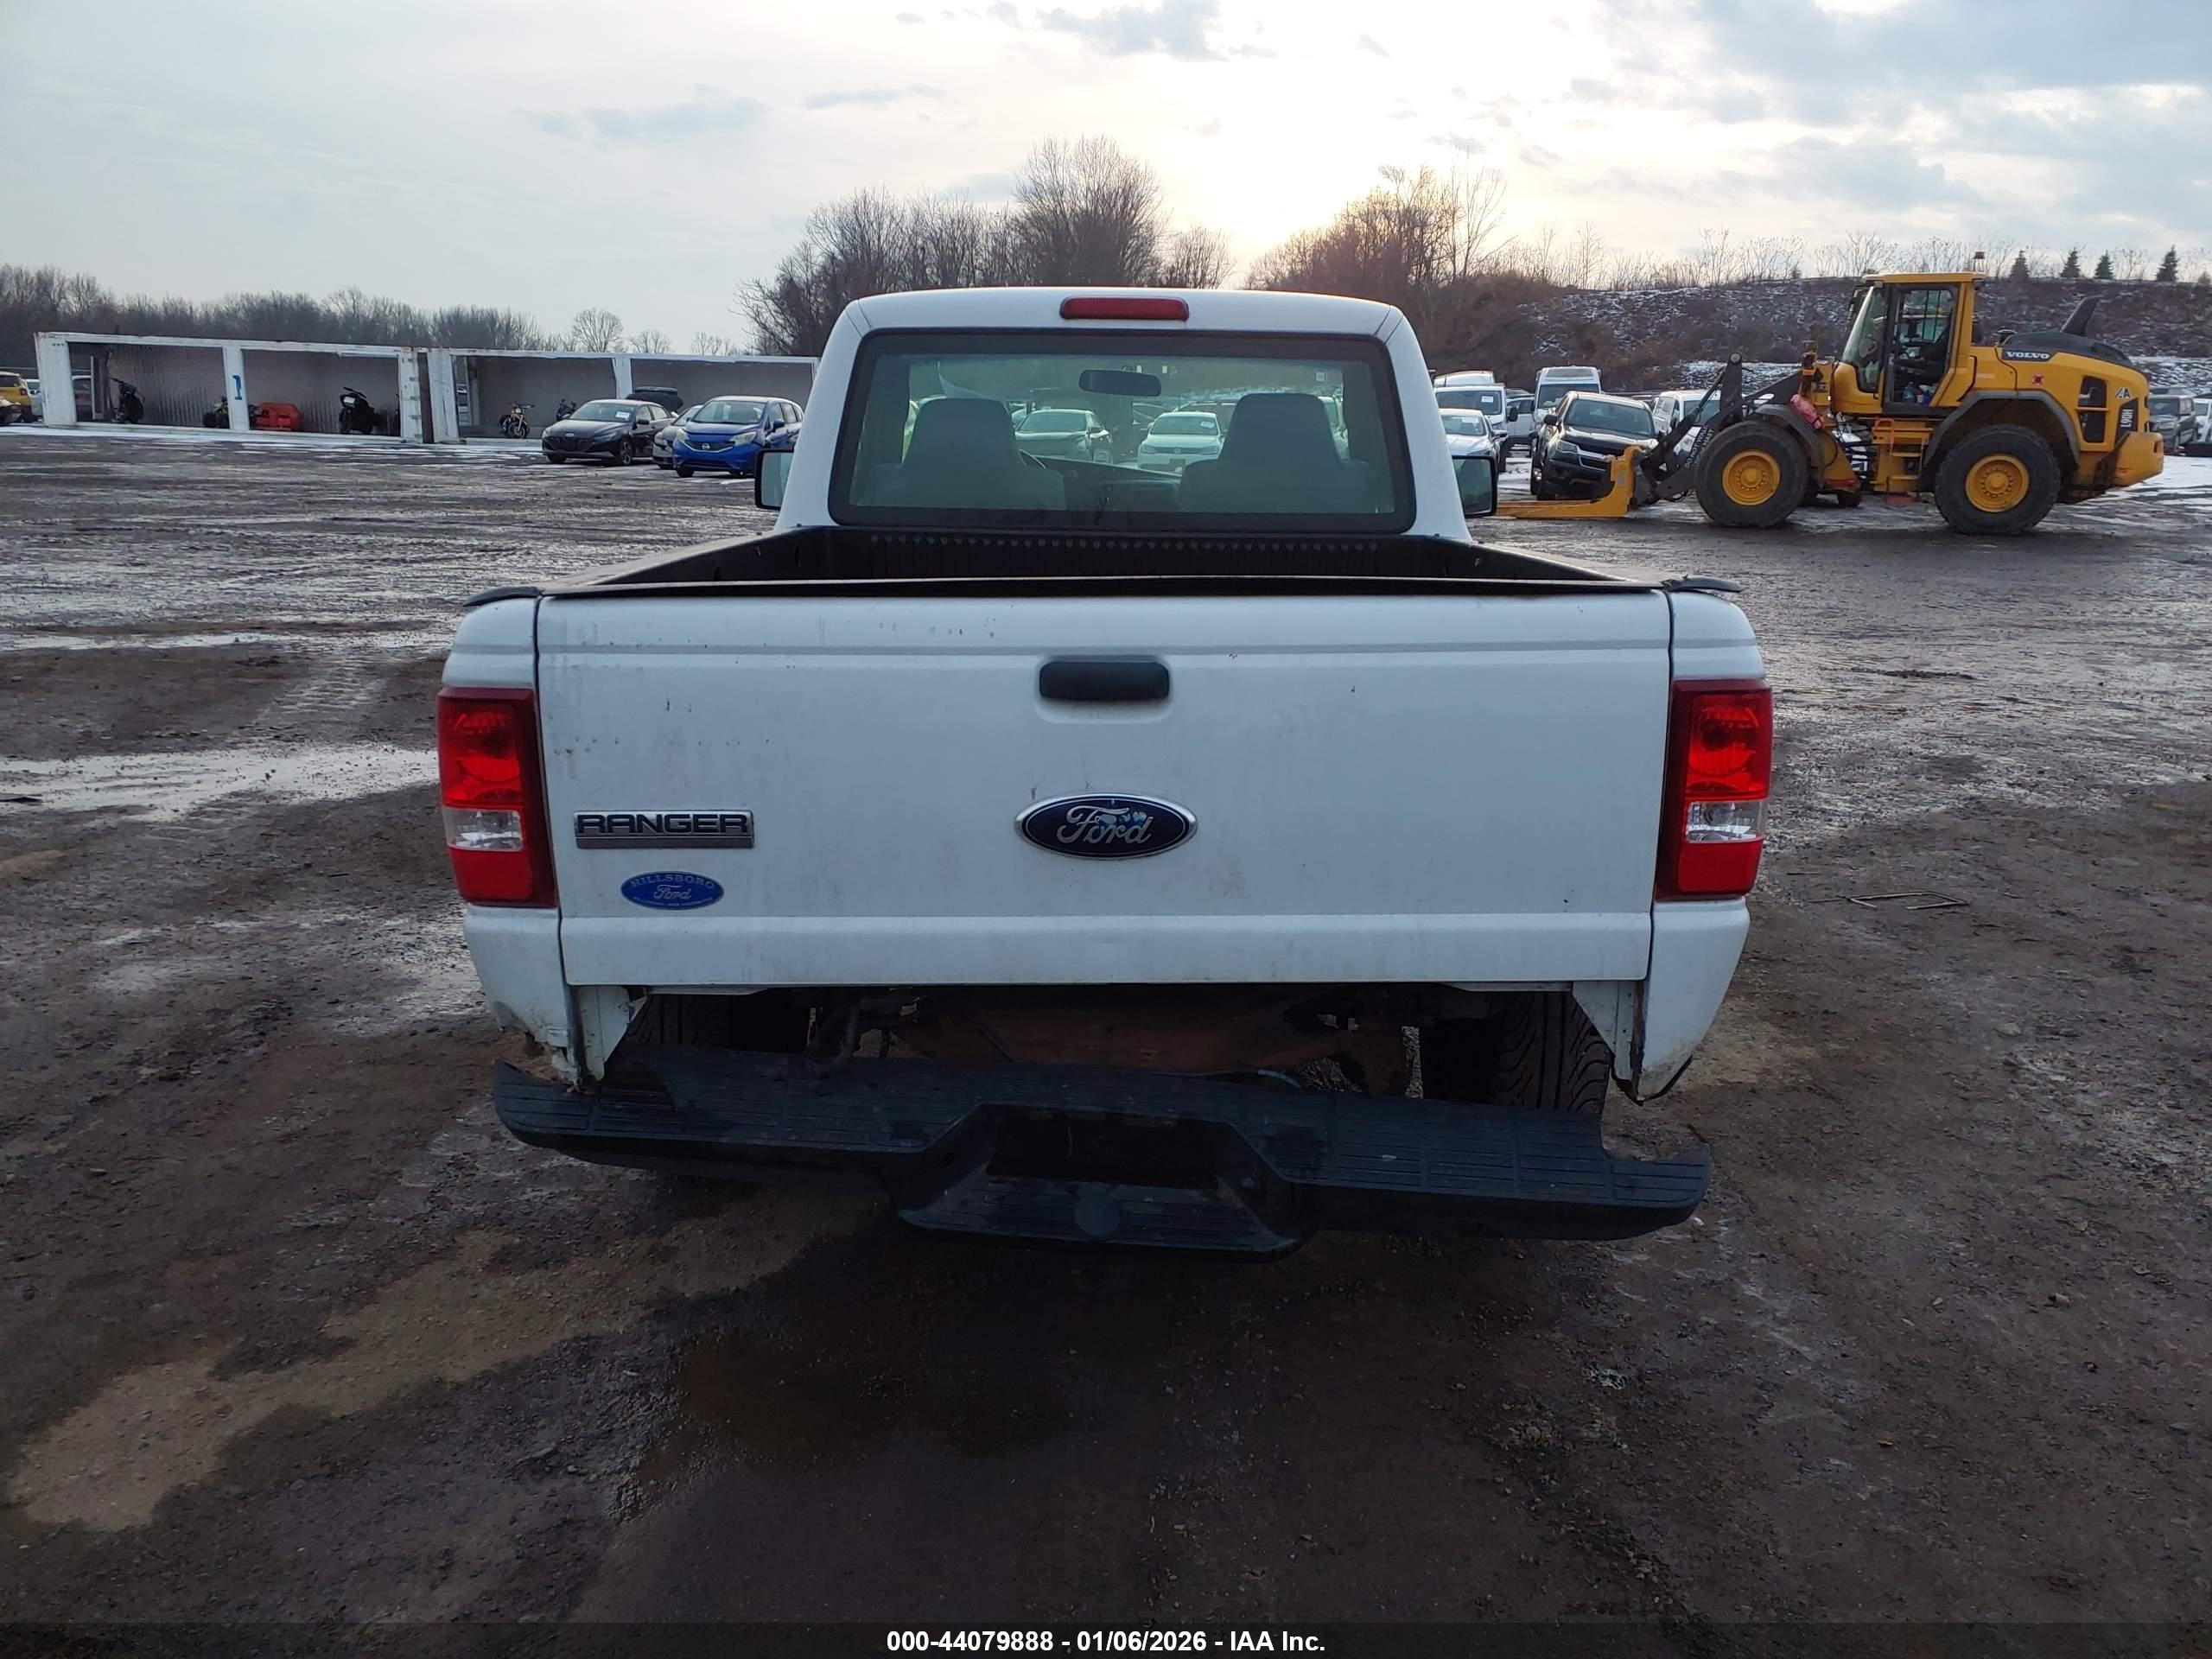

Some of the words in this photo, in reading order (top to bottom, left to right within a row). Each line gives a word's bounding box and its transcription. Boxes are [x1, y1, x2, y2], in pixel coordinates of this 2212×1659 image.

[2006, 351, 2050, 359] VOLVO
[2120, 409, 2134, 428] L90H
[576, 814, 747, 834] RANGER
[1057, 804, 1154, 844] Ford
[630, 874, 715, 889] HILLSBORO
[653, 883, 693, 899] Ford
